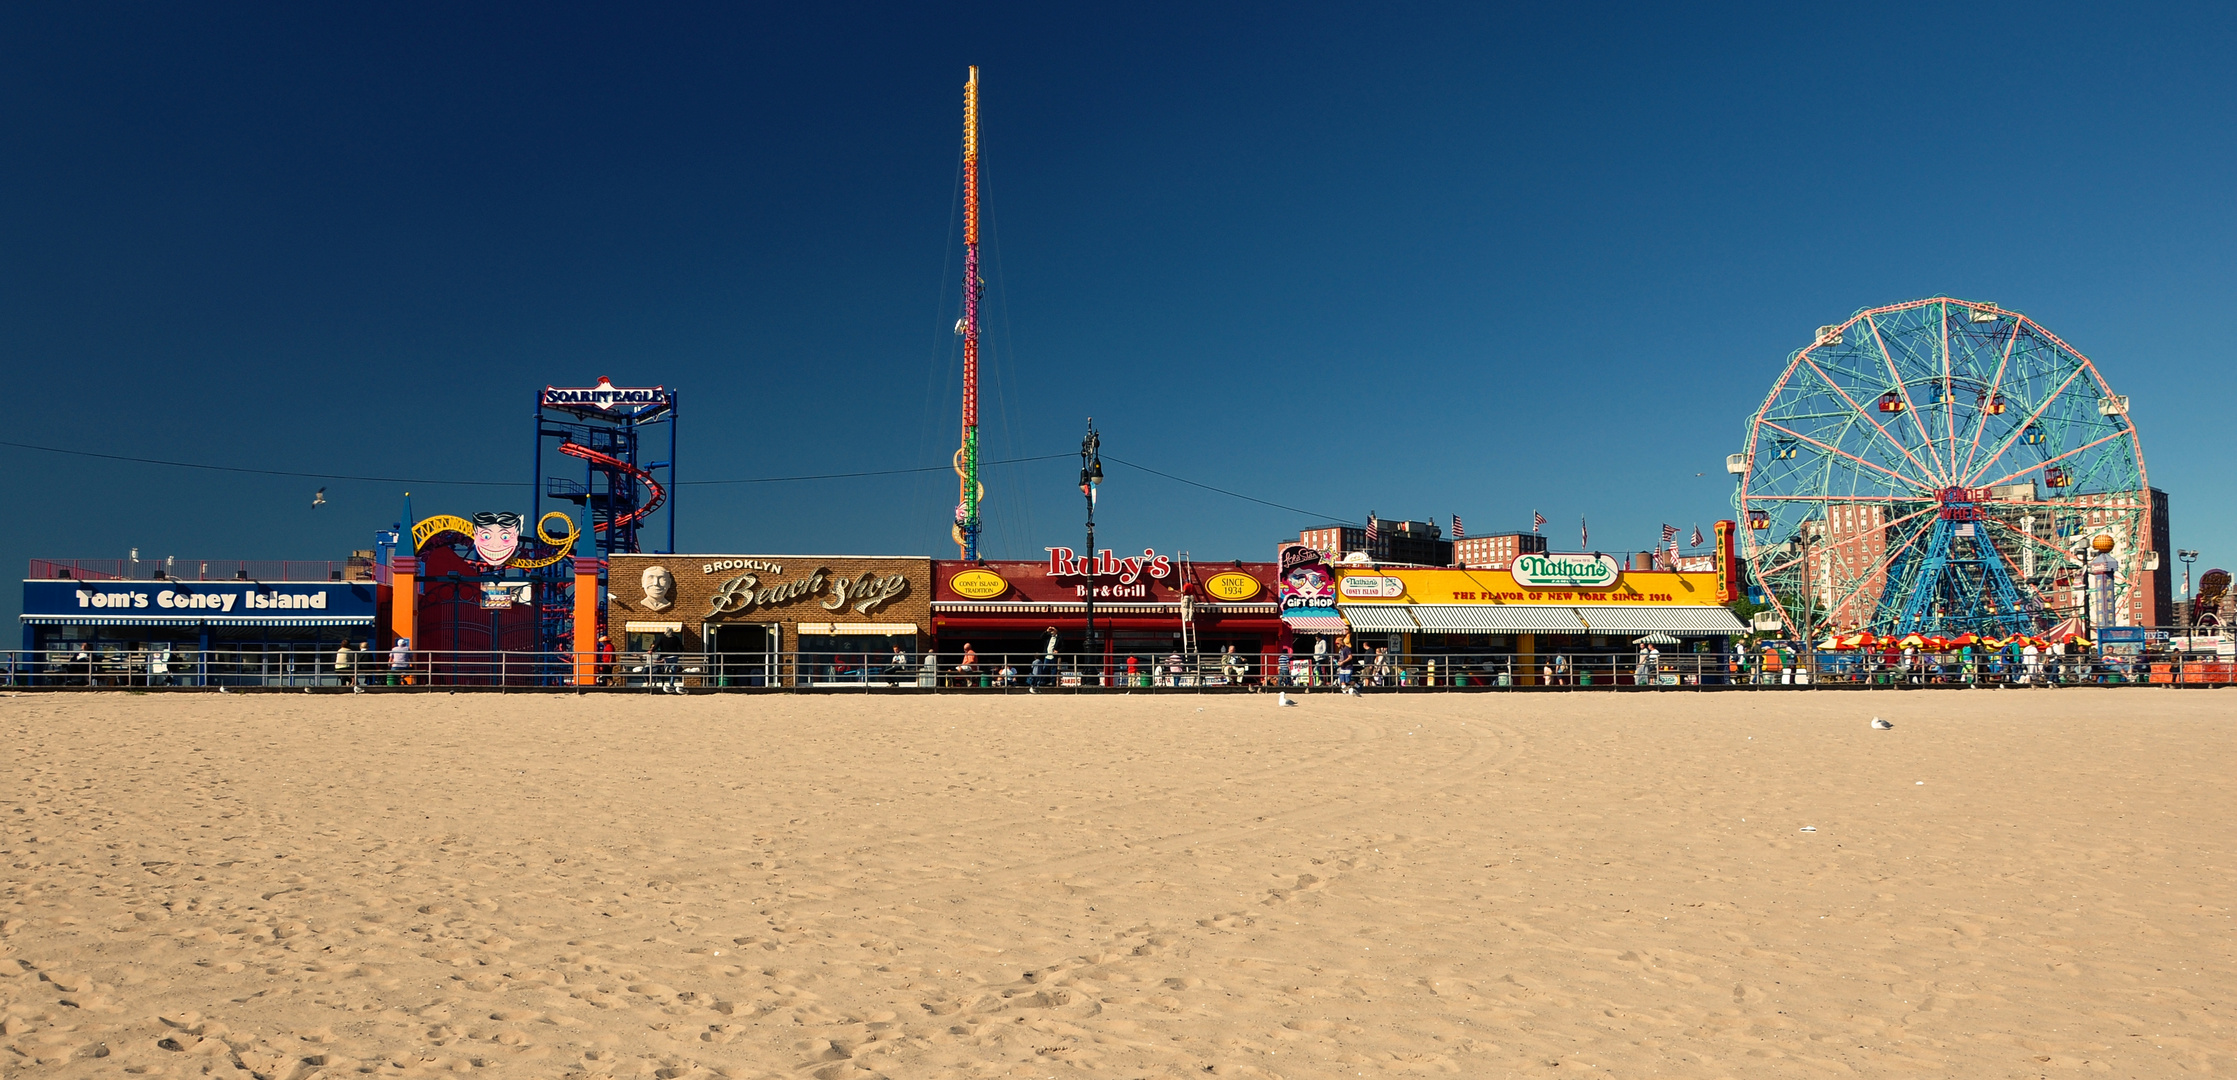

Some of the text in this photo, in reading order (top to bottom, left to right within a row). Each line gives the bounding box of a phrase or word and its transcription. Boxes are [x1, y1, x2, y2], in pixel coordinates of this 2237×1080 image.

[612, 390, 664, 403] EAGLE
[1934, 489, 1992, 502] WONDER
[1939, 506, 1989, 520] WHEEL
[1045, 547, 1171, 584] Ruby's
[1717, 528, 1725, 590] NATHANS
[703, 559, 782, 575] BROOKLYN
[1520, 556, 1608, 577] Nathan's
[1222, 578, 1245, 587] SINCE
[704, 565, 905, 618] Beach Shop
[1076, 584, 1099, 597] Br
[1113, 584, 1145, 597] Grill
[1224, 587, 1243, 595] 1934
[1453, 592, 1673, 601] THE FLAVOR OF NEW YORK SINCE 1916
[76, 590, 327, 612] Tom's Coney Island
[1309, 598, 1333, 607] SHOP
